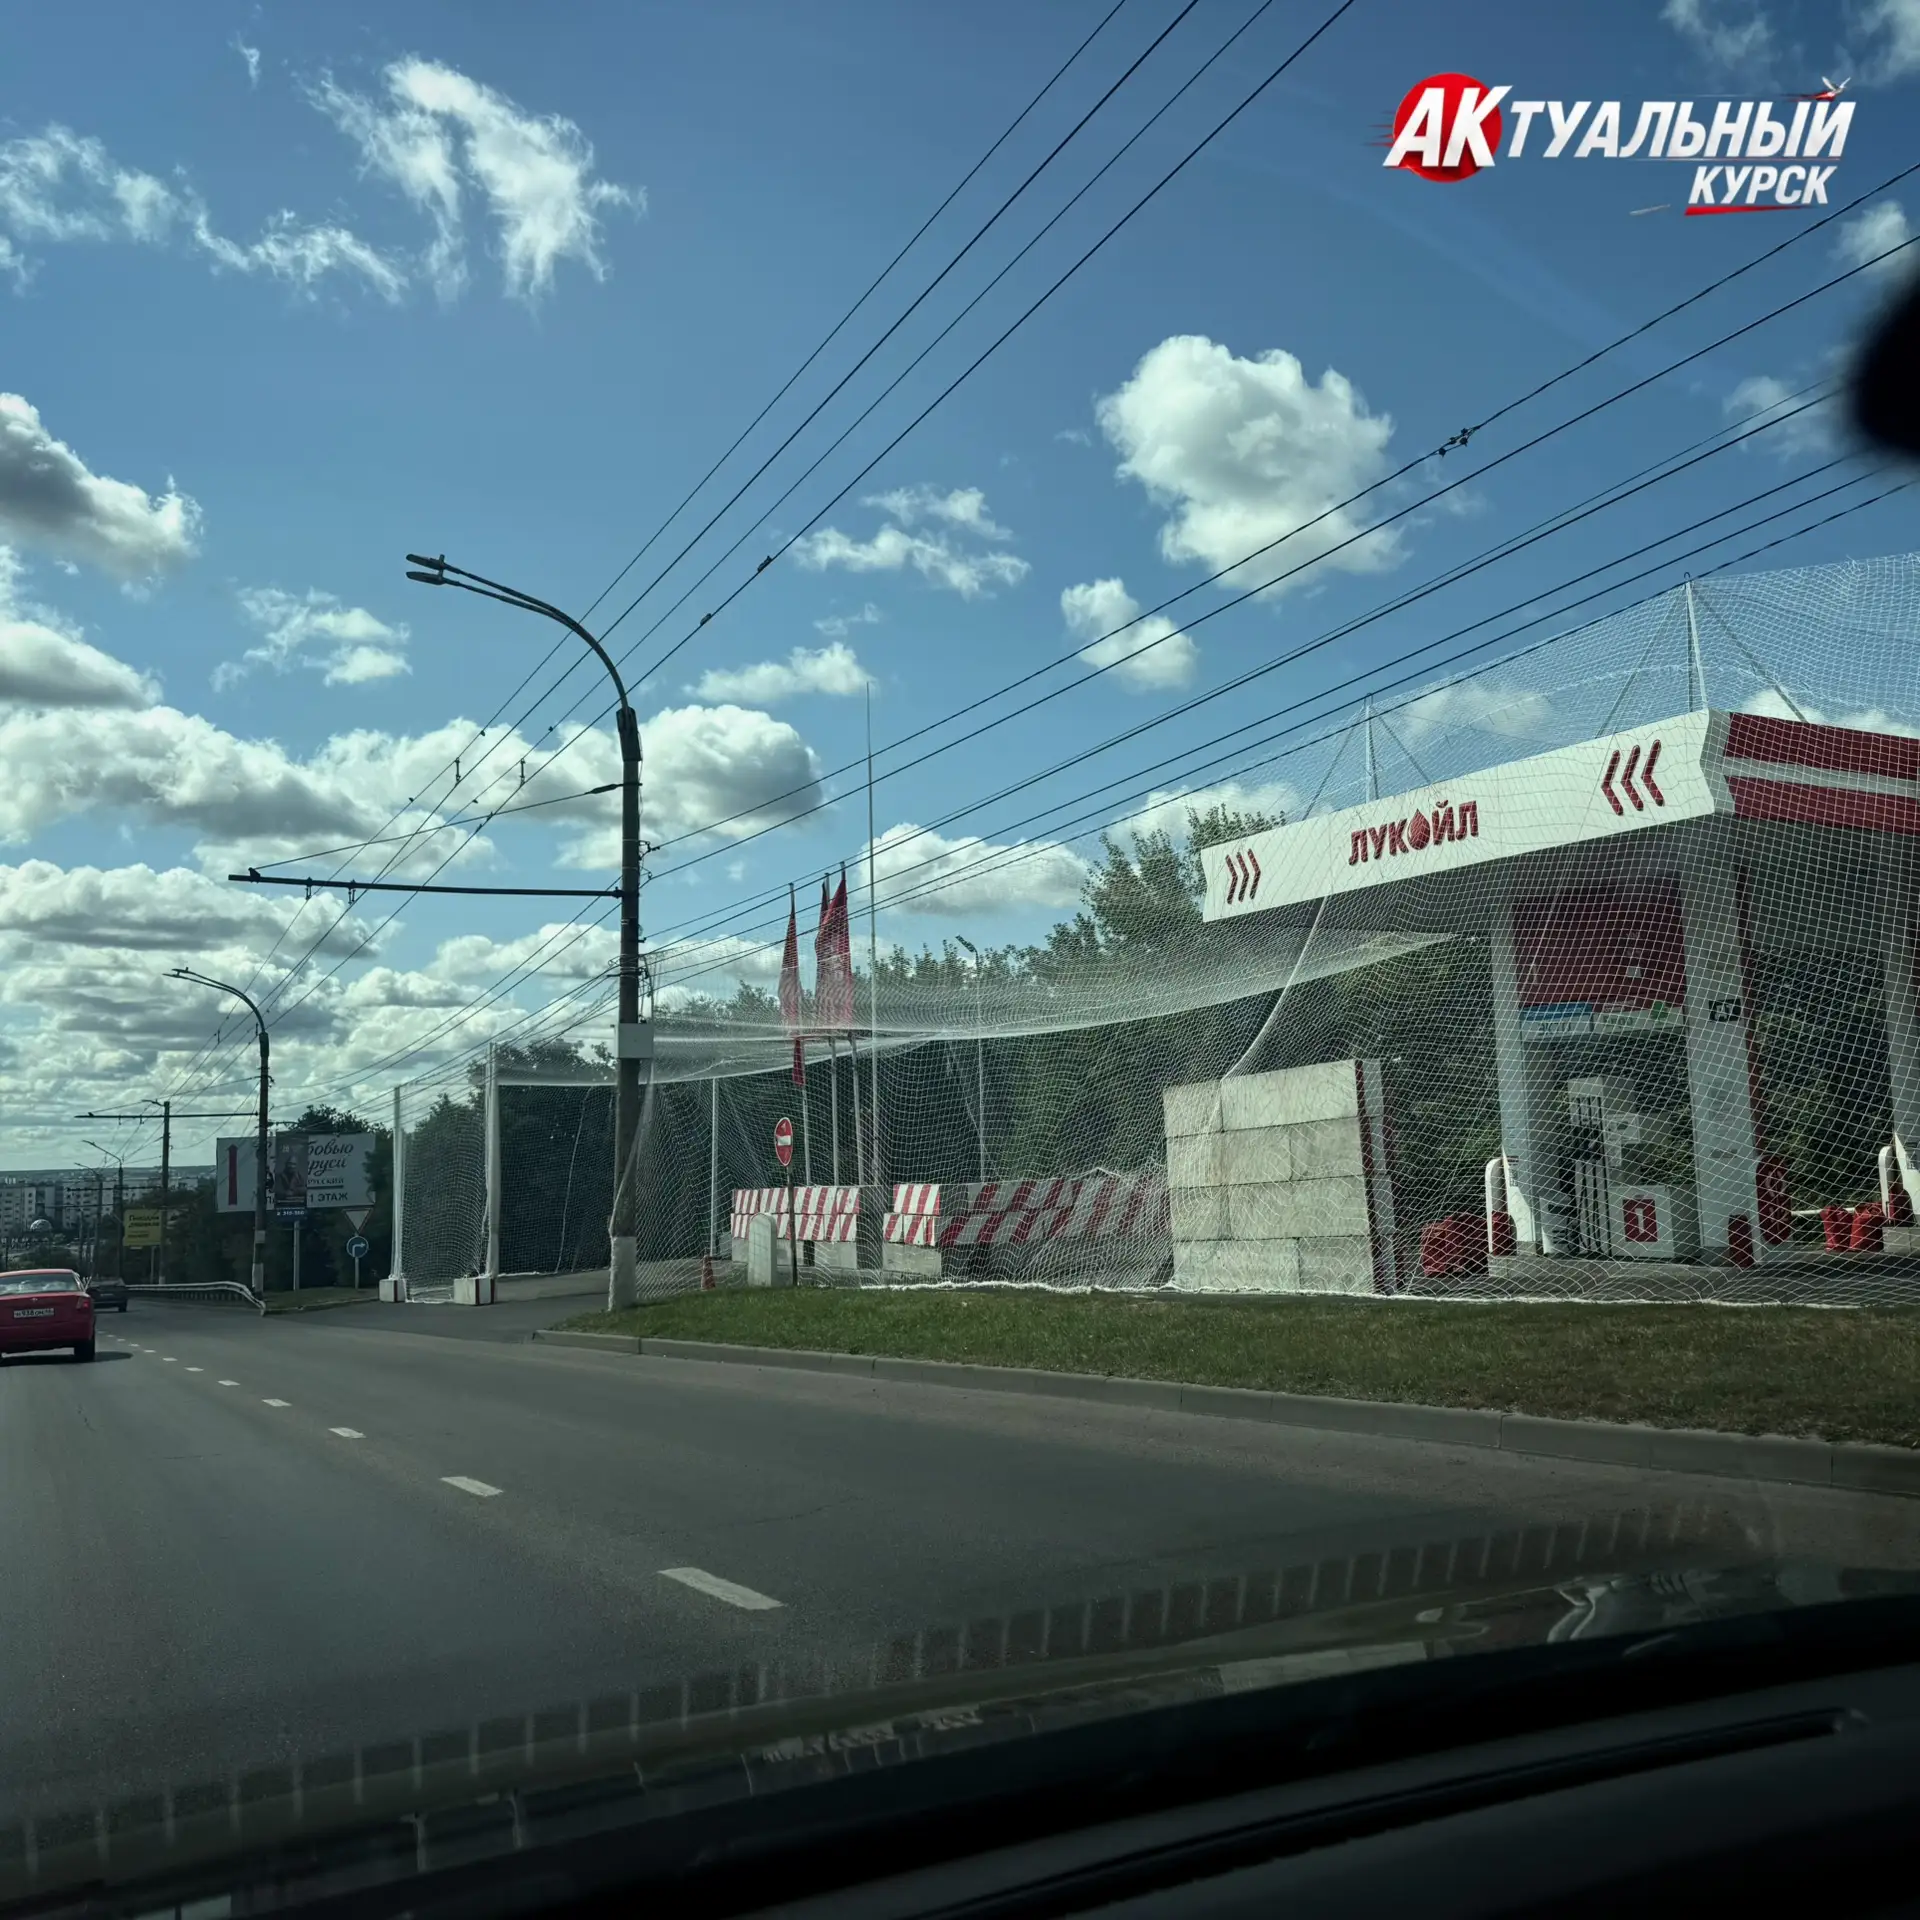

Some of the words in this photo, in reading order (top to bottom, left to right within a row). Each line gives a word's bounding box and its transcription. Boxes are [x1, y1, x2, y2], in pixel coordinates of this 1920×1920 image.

[1349, 800, 1479, 866] ЛУКОЙЛ
[318, 1192, 348, 1202] ЭТАЖ
[1634, 1207, 1645, 1234] 1
